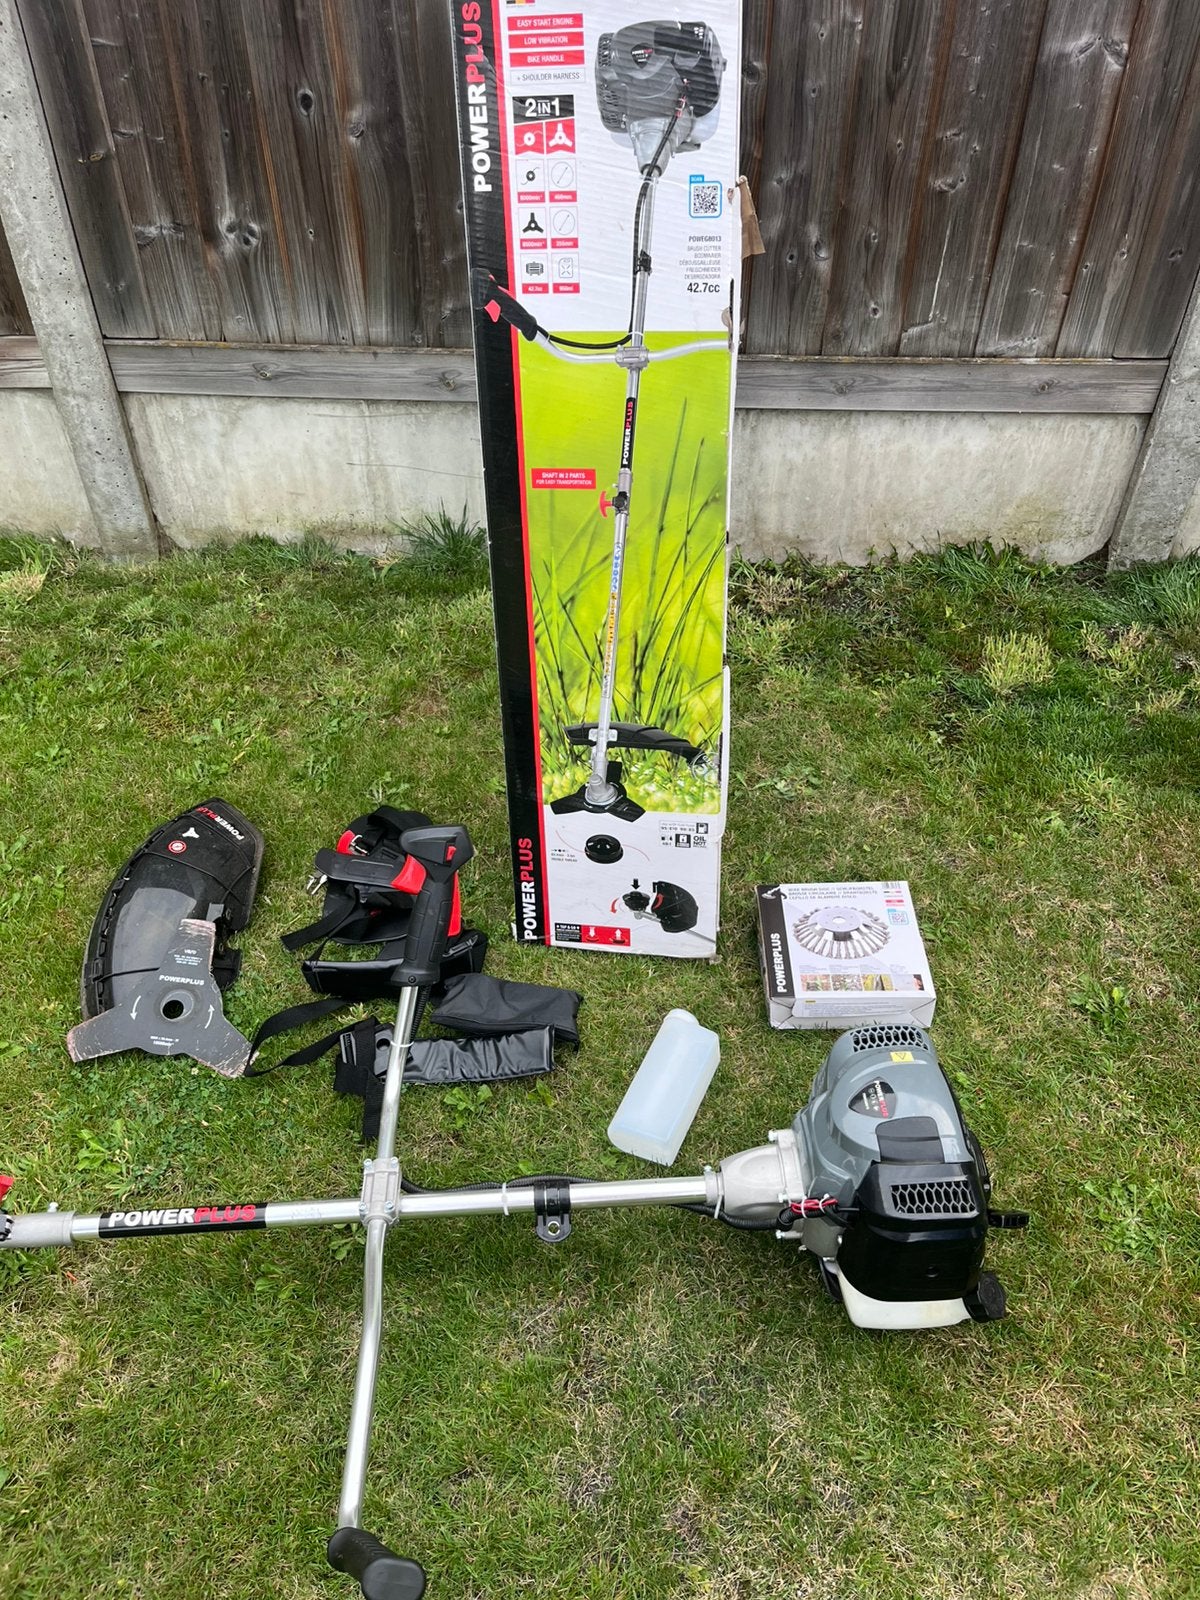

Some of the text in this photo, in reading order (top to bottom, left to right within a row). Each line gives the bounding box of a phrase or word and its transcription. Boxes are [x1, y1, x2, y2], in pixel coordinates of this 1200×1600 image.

[516, 17, 574, 27] EASY START ENGINE
[538, 36, 568, 44] VIBRATION
[522, 73, 552, 81] SHOULDER
[462, 2, 492, 192] POWERPLUS
[687, 283, 720, 293] 42.7cc
[623, 401, 633, 464] POWERPLUS
[518, 838, 538, 940] POWERPLUS
[770, 933, 787, 993] POWERPLUS
[159, 975, 204, 986] POWERPLUS
[874, 1081, 888, 1118] POWERPLUS
[108, 1204, 256, 1228] POWERPLUS
